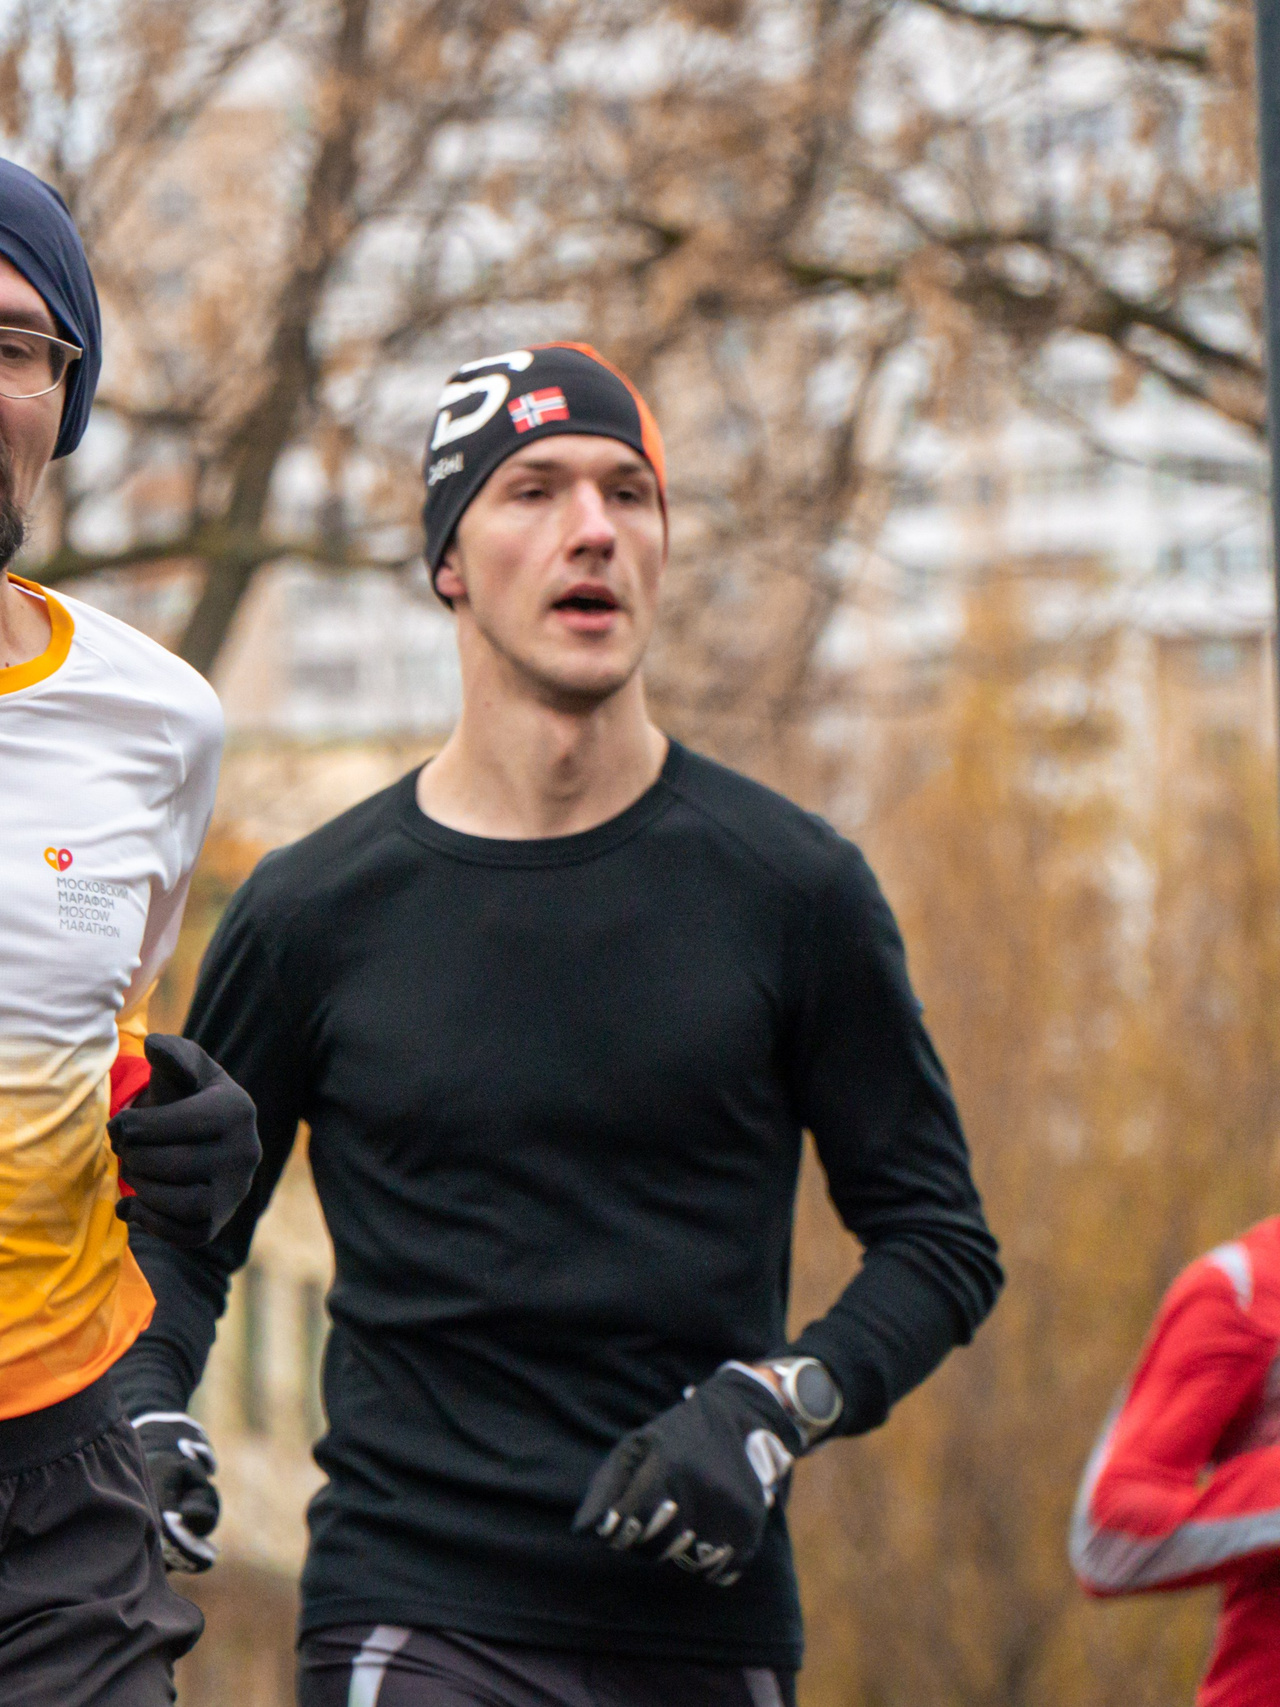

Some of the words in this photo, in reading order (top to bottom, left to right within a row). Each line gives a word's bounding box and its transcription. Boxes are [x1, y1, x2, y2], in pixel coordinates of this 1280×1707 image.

[58, 891, 115, 910] МАРАФОН
[58, 905, 110, 922] MOSCOW
[60, 919, 120, 938] MARATHON
